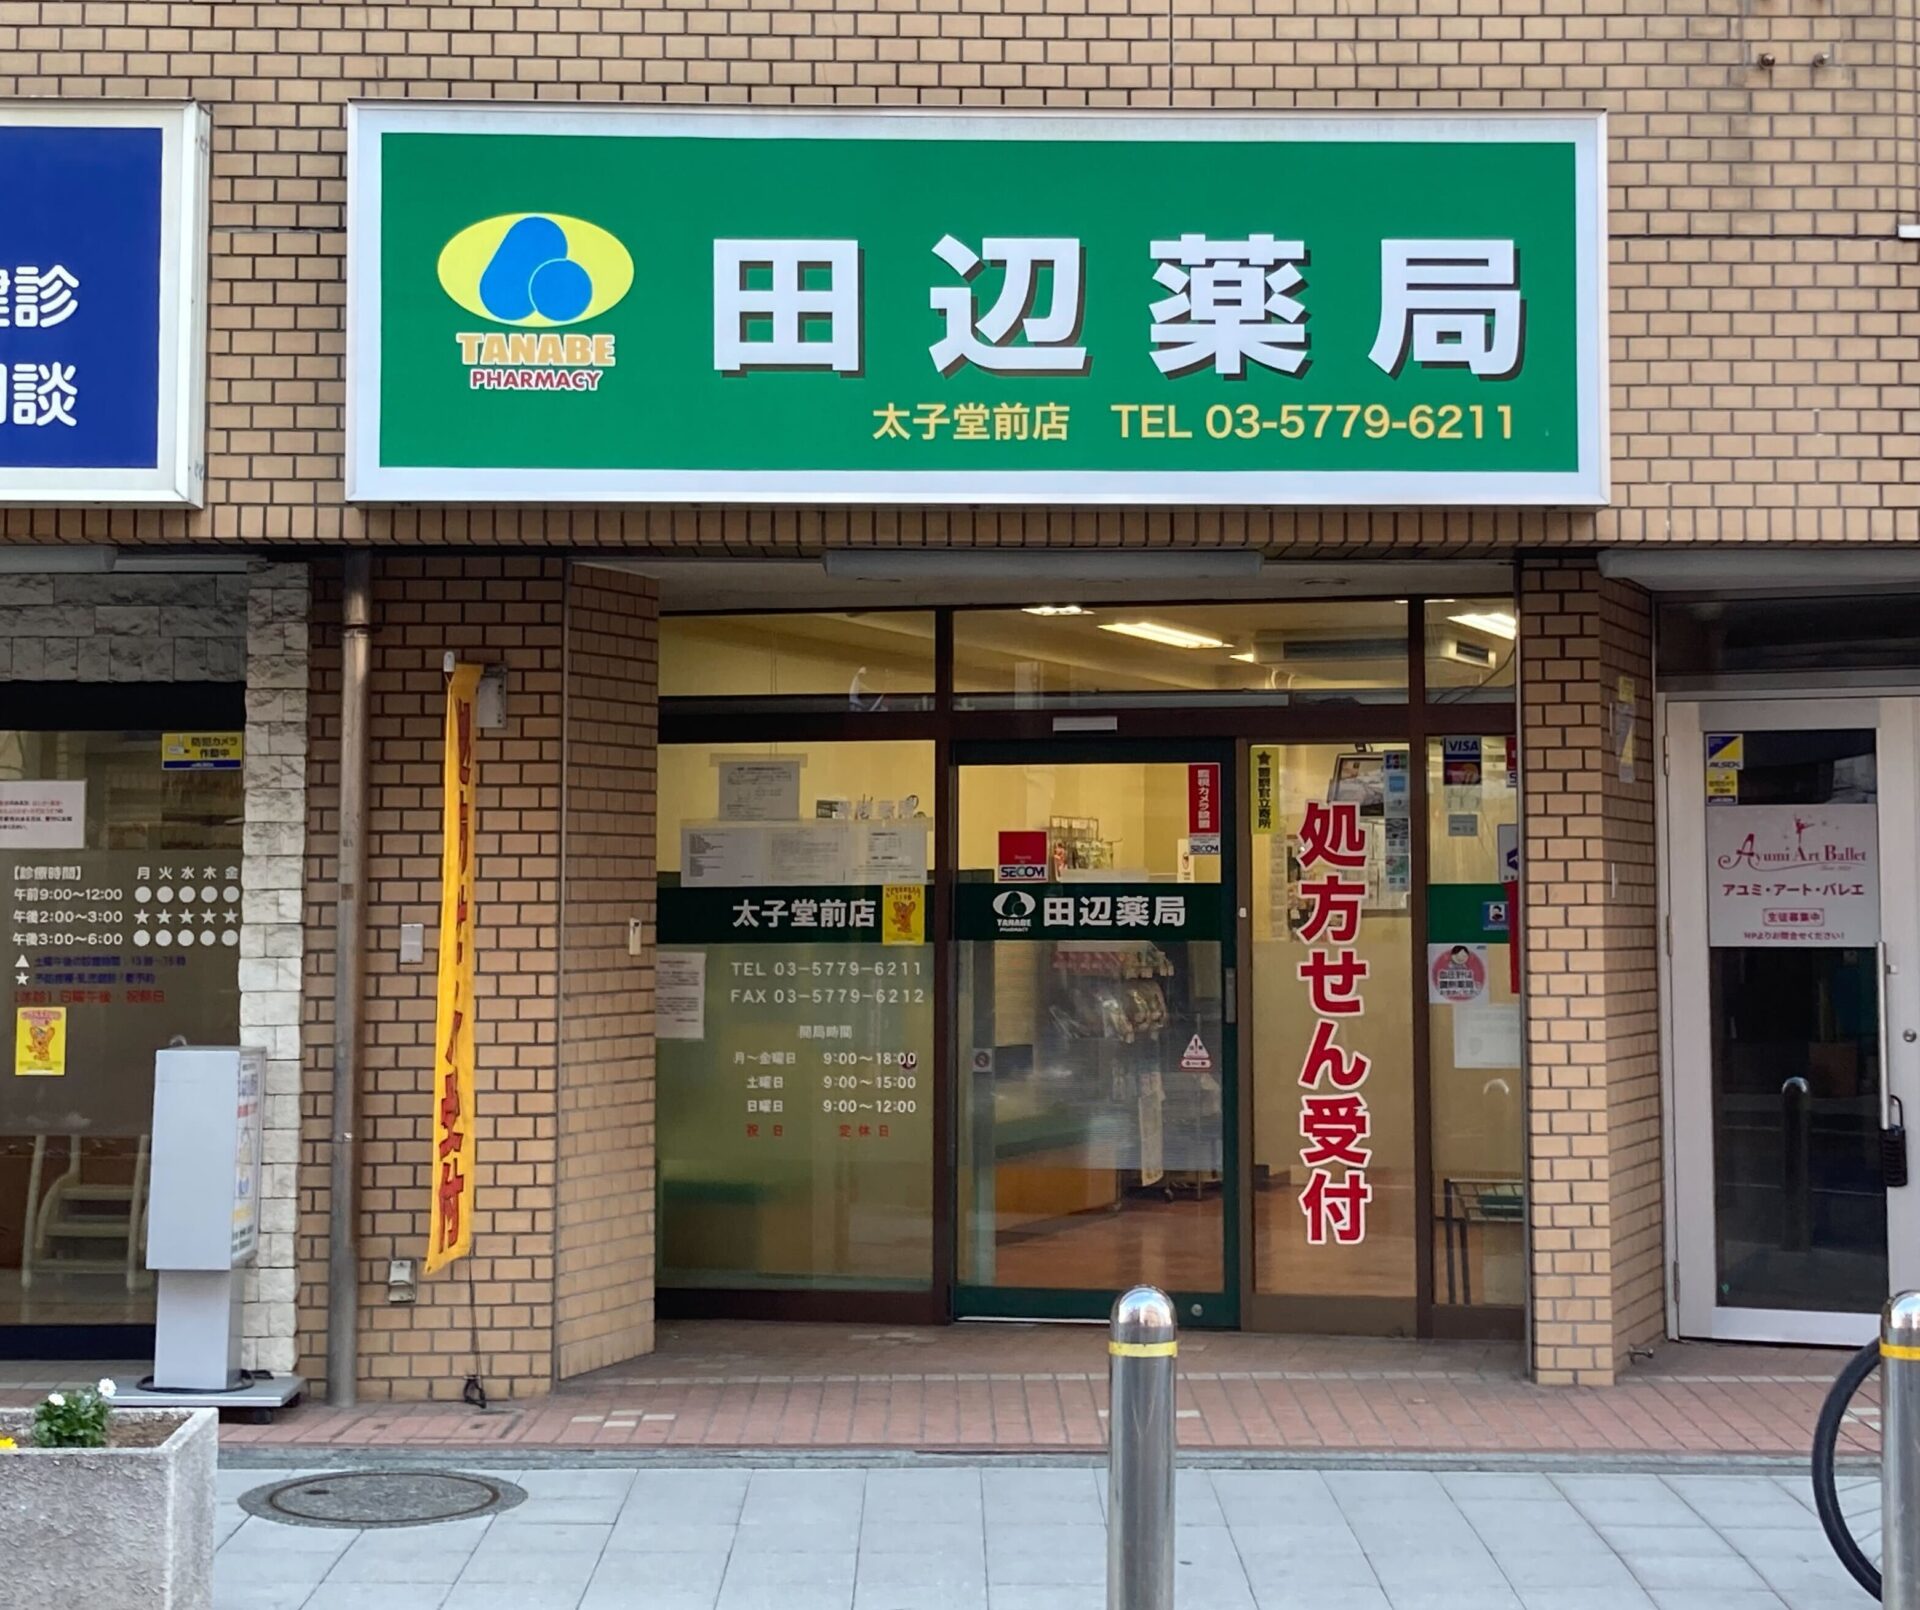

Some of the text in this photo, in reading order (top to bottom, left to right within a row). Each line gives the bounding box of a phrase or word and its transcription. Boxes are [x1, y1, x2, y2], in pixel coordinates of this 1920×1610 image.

[0, 265, 80, 328] 診
[713, 234, 1524, 376] 田辺薬局
[456, 332, 616, 367] TANABE
[470, 369, 603, 391] PHARMACY
[0, 361, 78, 427] 談
[873, 402, 1512, 440] 太子堂前店 TEL 03-5779-6211
[1449, 740, 1480, 752] VISA
[1718, 833, 1867, 871] Ayumi Art Ballet
[137, 866, 150, 880] 月
[158, 866, 173, 880] 火
[180, 866, 195, 880] 水
[203, 866, 217, 880] 木
[225, 866, 238, 880] 金
[1001, 866, 1045, 877] SECOM
[1722, 883, 1864, 897] アユミ・アート・バレエ
[731, 898, 876, 929] 太子堂前店
[1043, 896, 1187, 928] 田辺薬局
[731, 961, 922, 977] TEL 03-5779-6211
[730, 989, 925, 1004] FAX 03-5779-6212
[1297, 800, 1371, 1245] 処方せん受付
[746, 1076, 784, 1090] 土曜日
[747, 1100, 784, 1113] 日曜日
